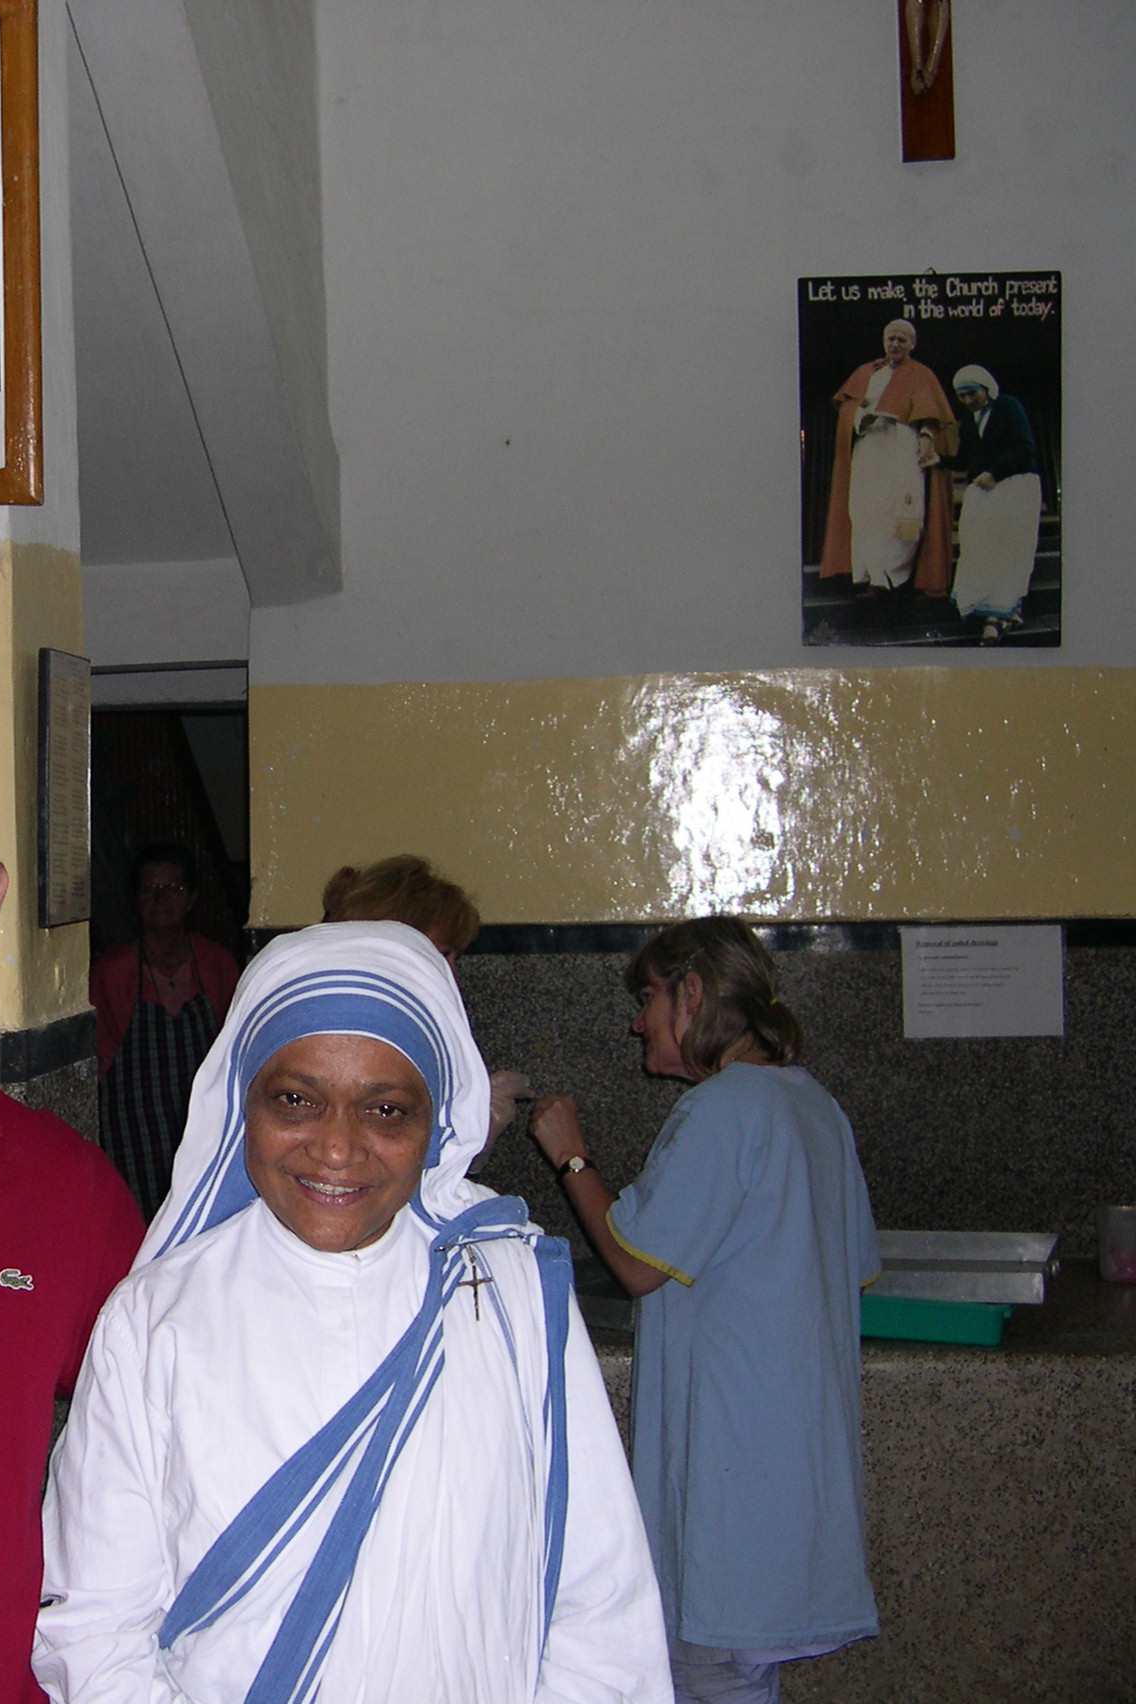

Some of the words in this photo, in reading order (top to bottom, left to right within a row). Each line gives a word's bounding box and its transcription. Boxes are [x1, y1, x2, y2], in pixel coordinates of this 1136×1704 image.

[808, 281, 836, 301] Let
[841, 285, 861, 301] us
[868, 280, 904, 300] make
[912, 278, 939, 298] the
[946, 277, 998, 297] Church
[1005, 275, 1058, 300] present
[903, 297, 916, 319] in
[918, 299, 944, 319] the
[948, 299, 984, 318] world
[988, 298, 1005, 317] of
